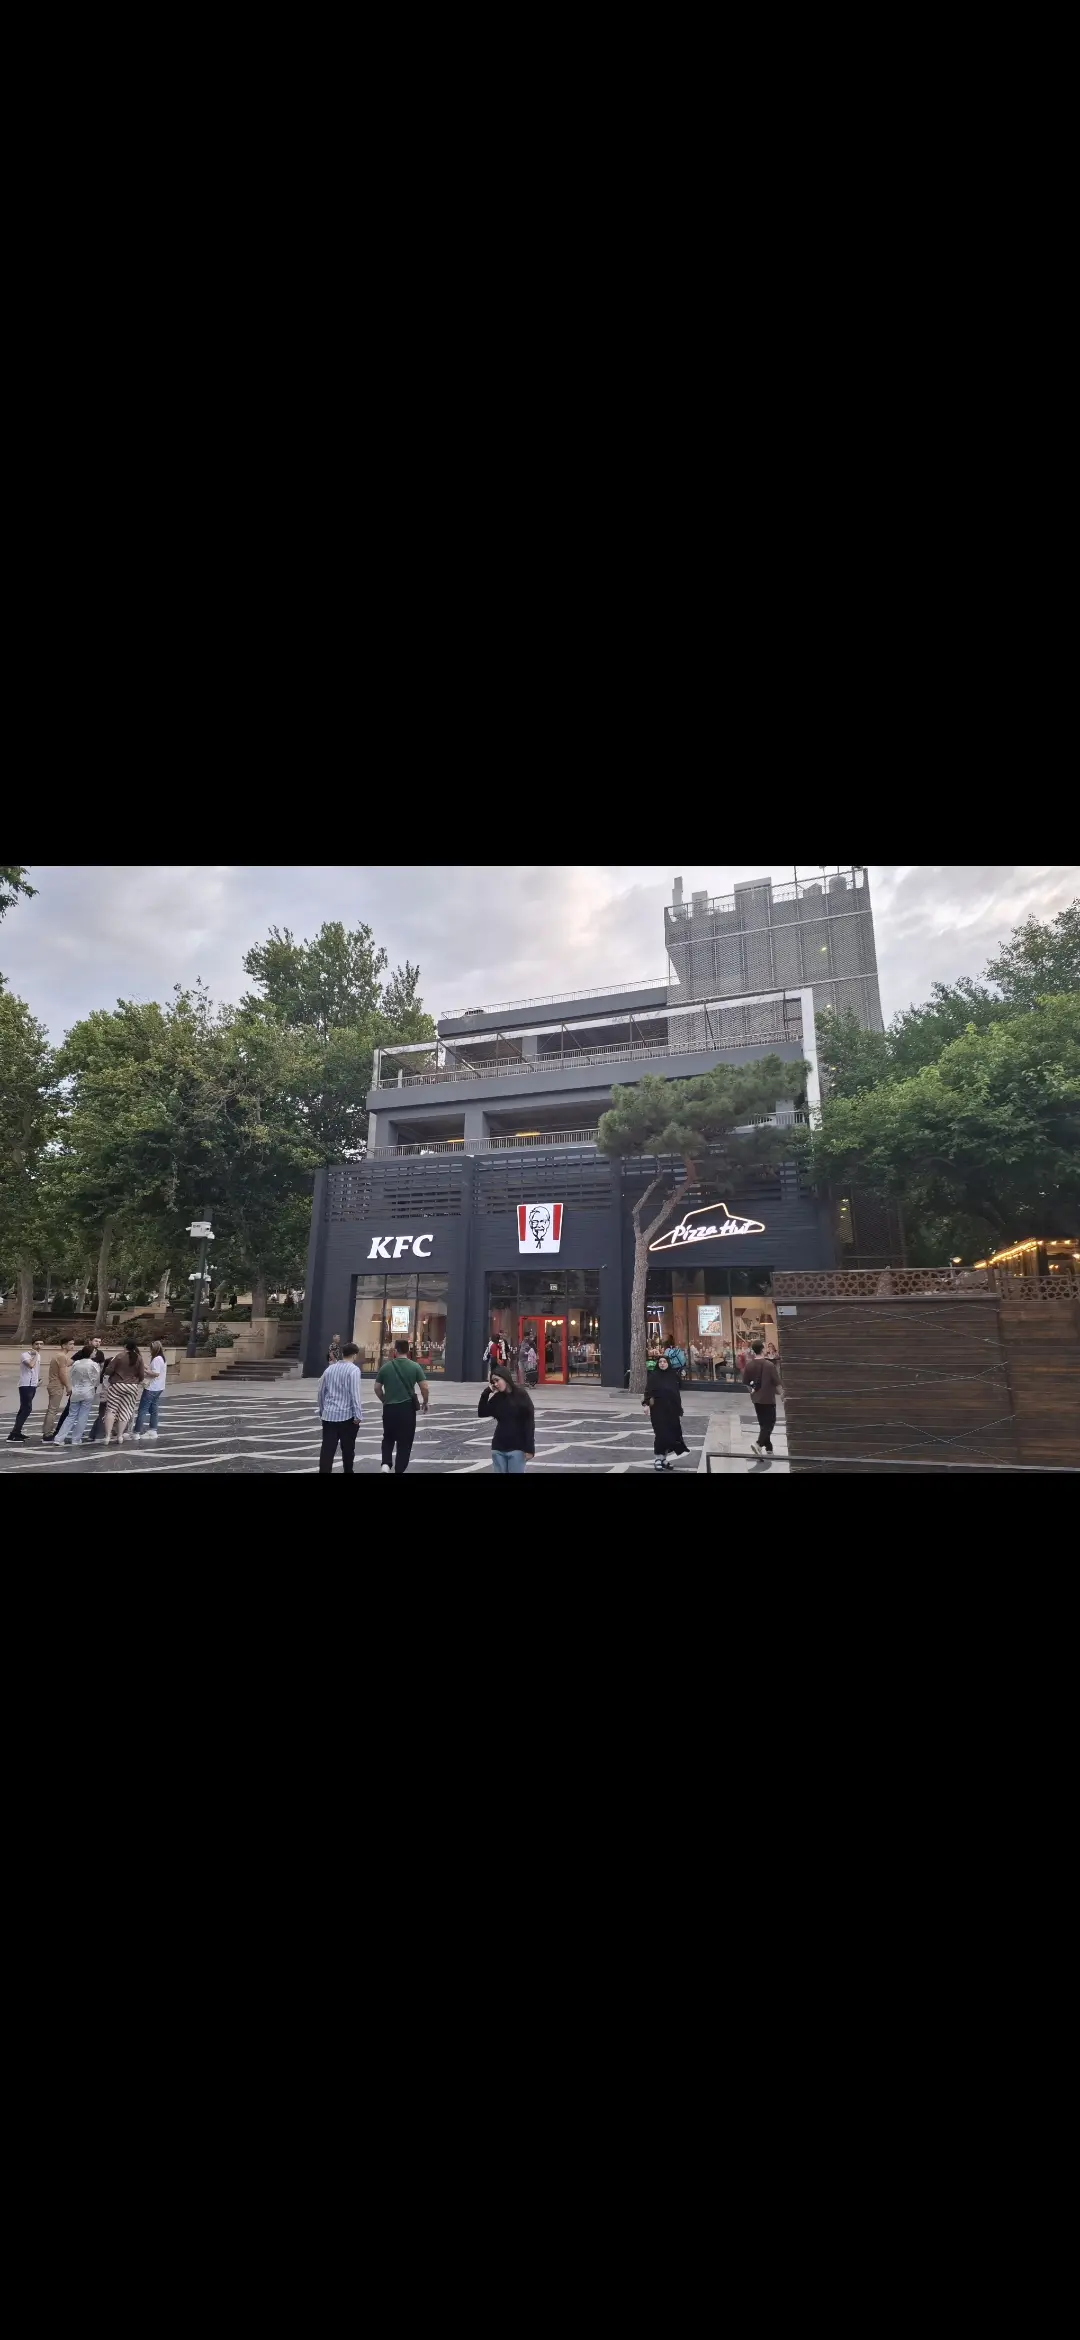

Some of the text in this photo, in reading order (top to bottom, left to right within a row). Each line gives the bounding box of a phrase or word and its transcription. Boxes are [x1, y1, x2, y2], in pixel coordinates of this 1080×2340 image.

[671, 1220, 753, 1244] Pizza Hut
[367, 1234, 434, 1258] KFC
